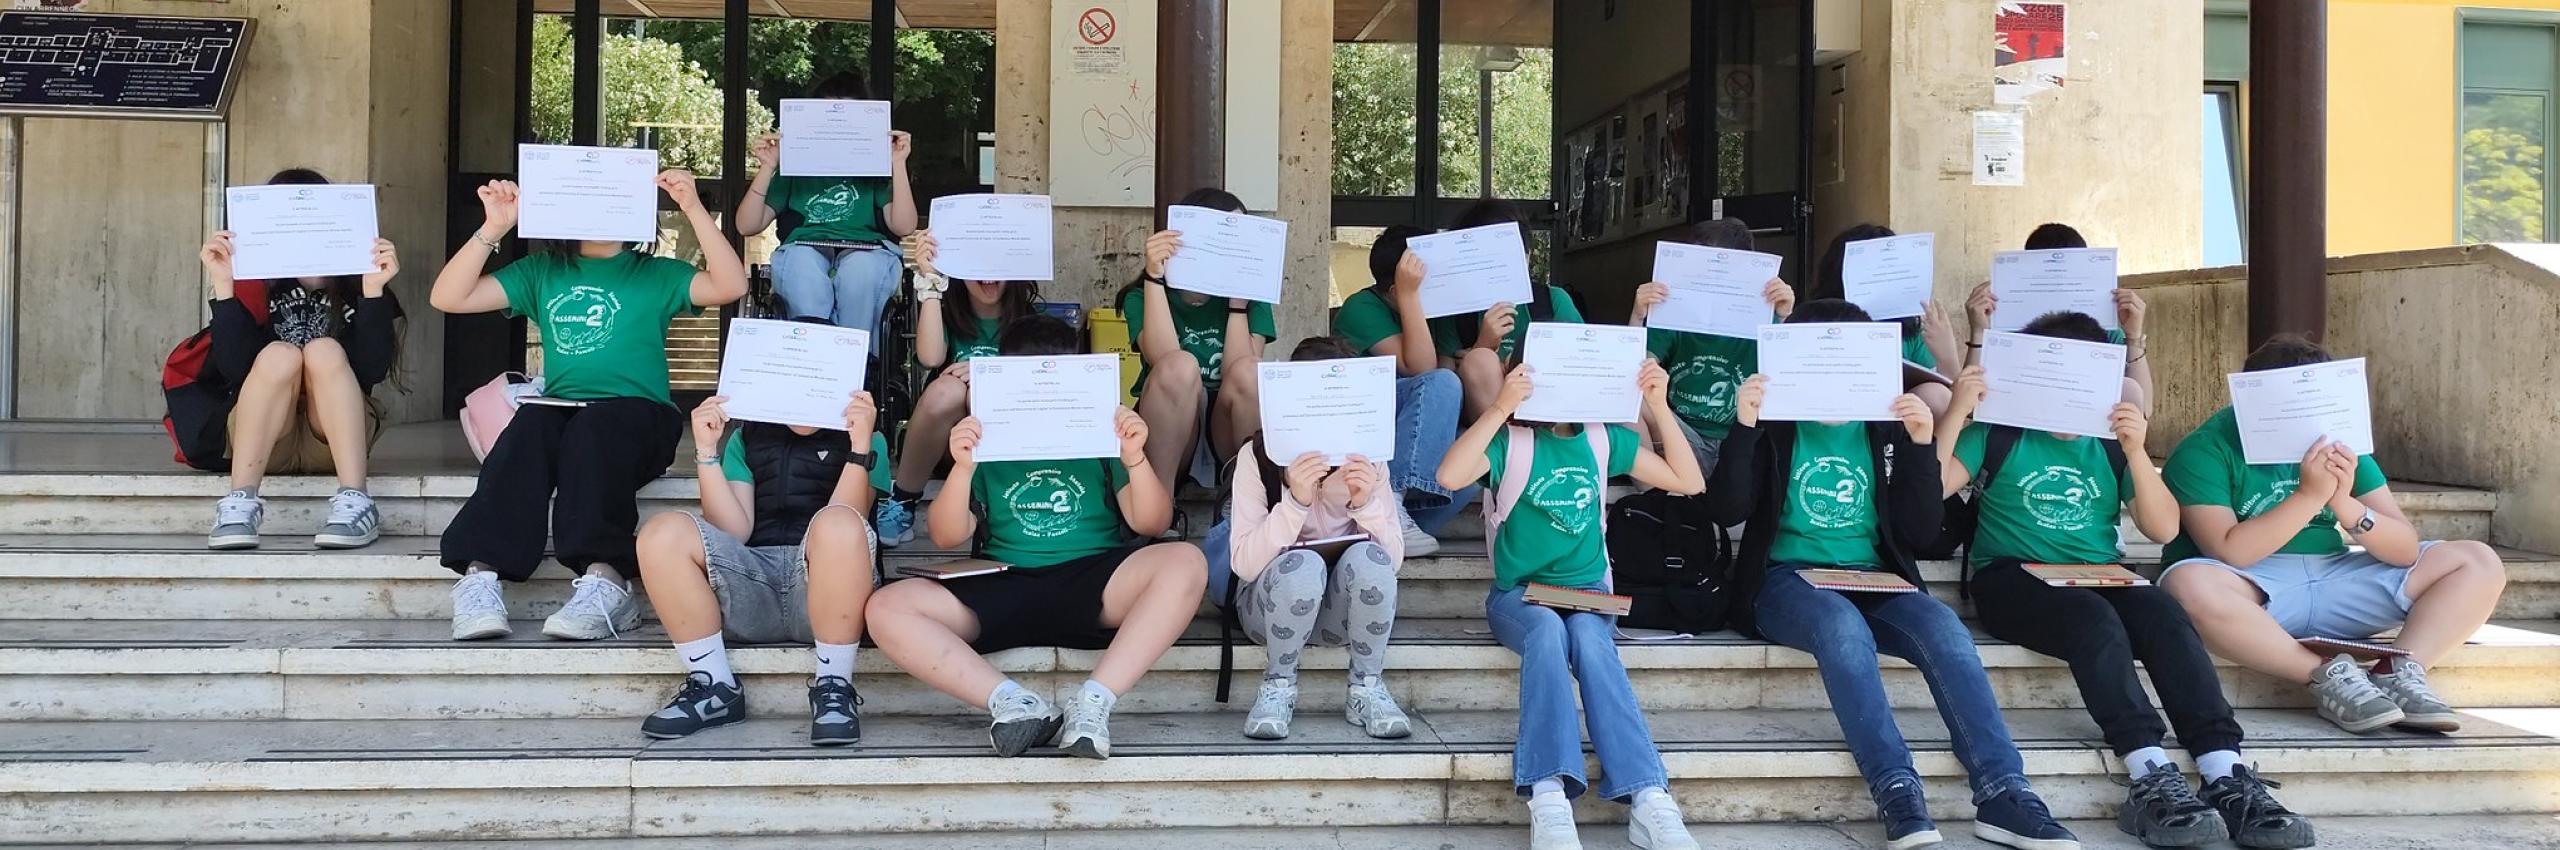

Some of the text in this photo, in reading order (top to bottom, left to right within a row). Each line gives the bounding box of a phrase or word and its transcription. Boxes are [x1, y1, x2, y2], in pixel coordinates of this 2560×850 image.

[833, 190, 849, 206] 2
[554, 303, 607, 327] ASSEMINI 2
[1707, 380, 1731, 407] 2
[1550, 465, 1589, 475] Comprensivo
[1016, 489, 1072, 513] ASSEMINI 2
[1540, 499, 1576, 507] ASSEMINI
[1805, 479, 1857, 504] ASSEMINI 2
[2031, 486, 2087, 507] ASSEMINI 2
[2237, 491, 2263, 516] Istituto
